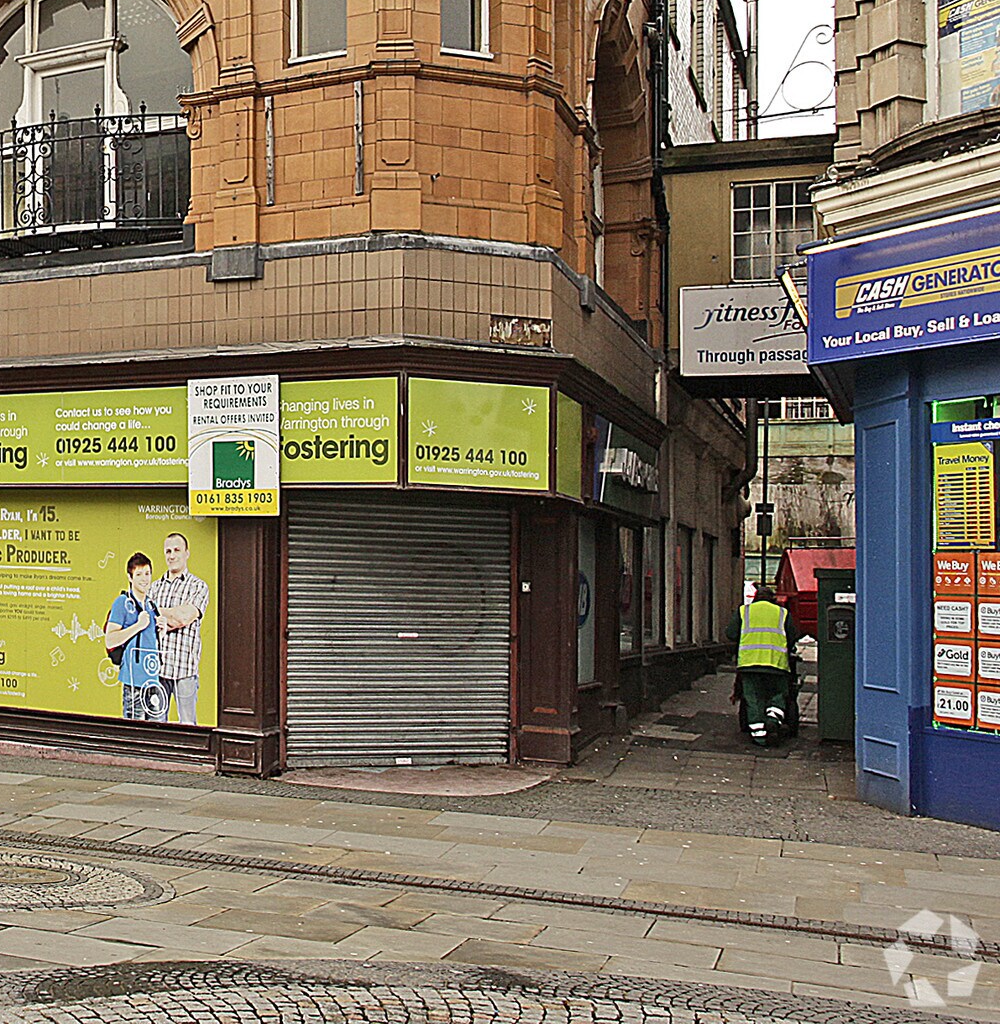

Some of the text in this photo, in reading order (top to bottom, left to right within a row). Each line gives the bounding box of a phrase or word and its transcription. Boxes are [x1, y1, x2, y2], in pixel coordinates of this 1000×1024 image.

[855, 275, 909, 303] CASH
[783, 319, 804, 331] FO
[822, 335, 852, 349] Your
[855, 327, 890, 345] Local
[894, 324, 924, 339] Buy,
[927, 316, 955, 333] Sell
[958, 314, 971, 328] &
[697, 349, 755, 365] Through
[194, 382, 273, 396] SHOP FIT TO YOUR
[203, 395, 267, 410] REQUIREMENTS
[280, 396, 375, 415] hanging lives in
[8, 410, 17, 421] in
[55, 405, 172, 418] Contact us to see how you
[193, 412, 275, 425] RENTAL OFFERS INVITED
[341, 414, 390, 431] through
[55, 418, 151, 434] could change a life...
[952, 421, 982, 433] Instant
[55, 435, 176, 454] 01925 444 100
[415, 444, 527, 466] 01925 444 100
[938, 455, 990, 465] Travel Money
[55, 459, 63, 467] or
[64, 458, 76, 467] visit
[423, 465, 436, 473] visit
[216, 478, 251, 490] Bradys
[196, 493, 273, 505] 0161 835 1903
[39, 505, 59, 522] 15.
[211, 505, 261, 513] www.bradys.co.uk
[146, 513, 169, 521] Borough
[946, 649, 969, 660] Gold
[1, 677, 18, 688] 100
